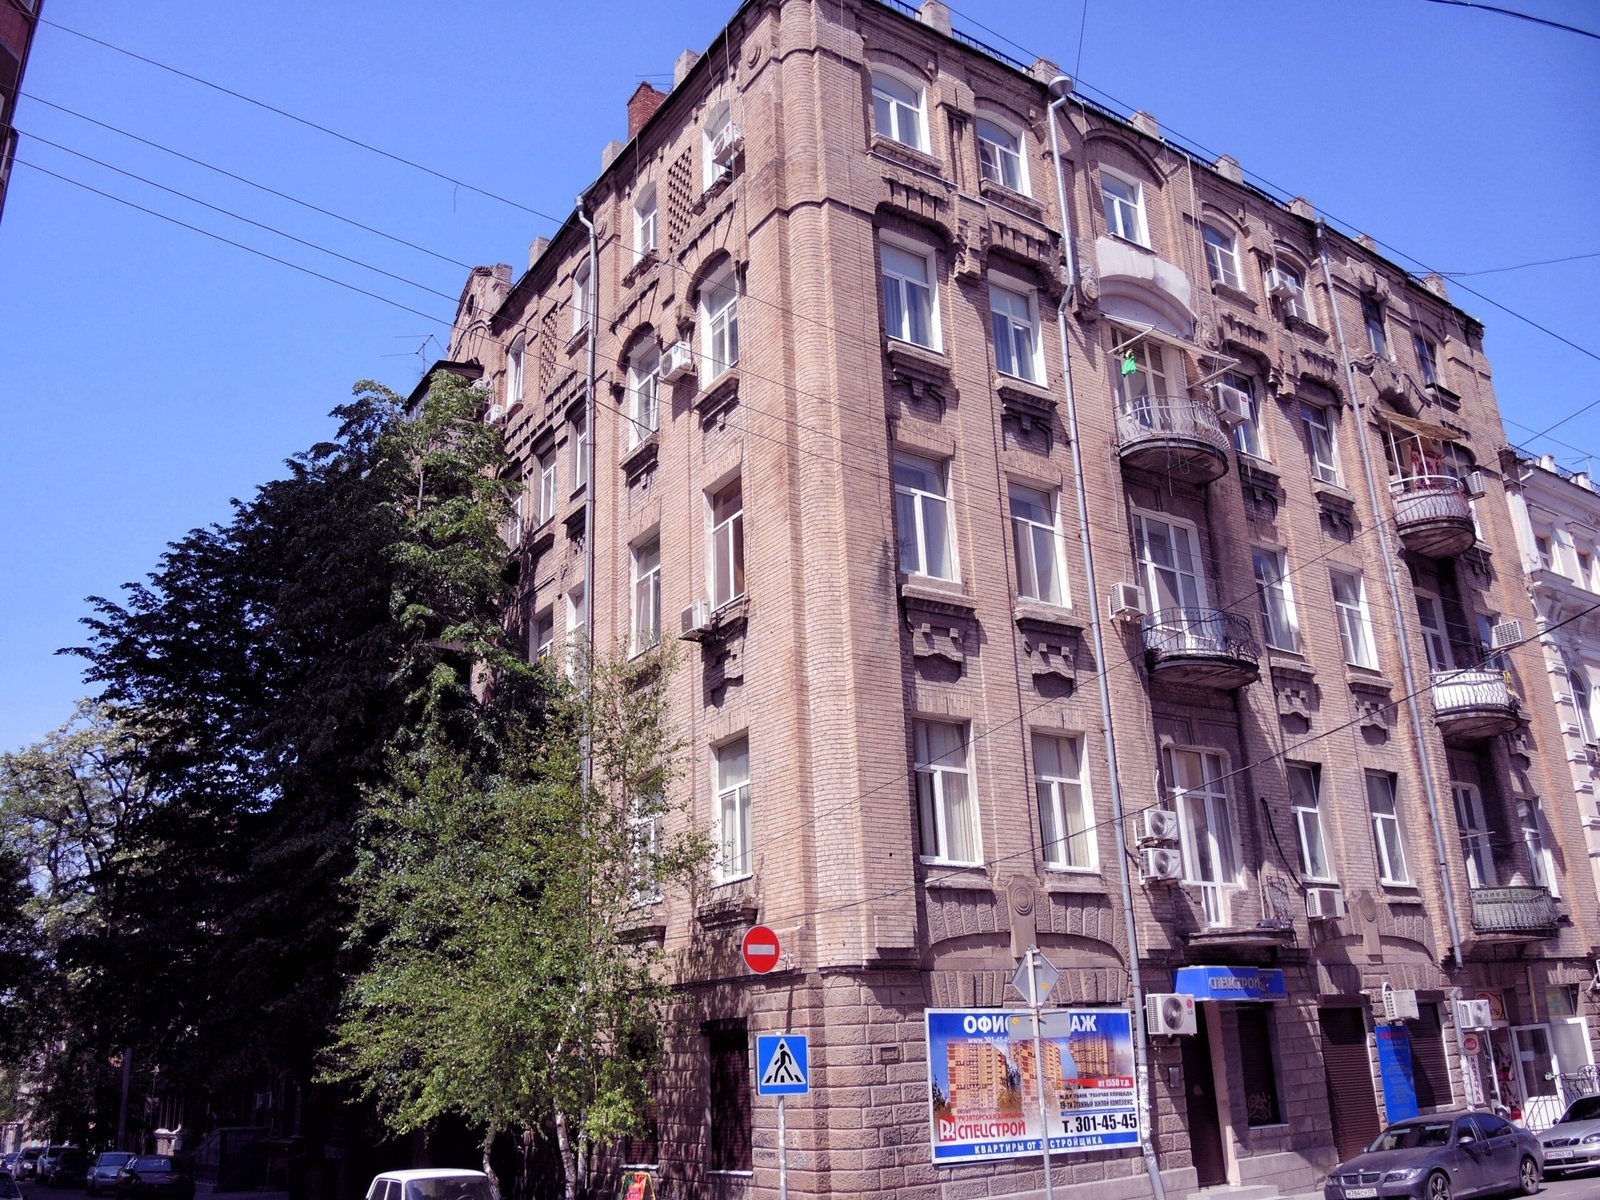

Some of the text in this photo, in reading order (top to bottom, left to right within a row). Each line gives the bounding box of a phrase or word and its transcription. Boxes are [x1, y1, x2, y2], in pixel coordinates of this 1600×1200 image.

[1208, 976, 1260, 990] СПЕЦСТРОЙ
[963, 1015, 1009, 1034] ОФИ
[958, 1120, 1026, 1140] СПЕЦСТРОЙ
[1075, 1113, 1138, 1132] 301-45-45
[974, 1136, 1102, 1154] КВАРТИРЫ ОТ ЗСТРОЙЩИКА
